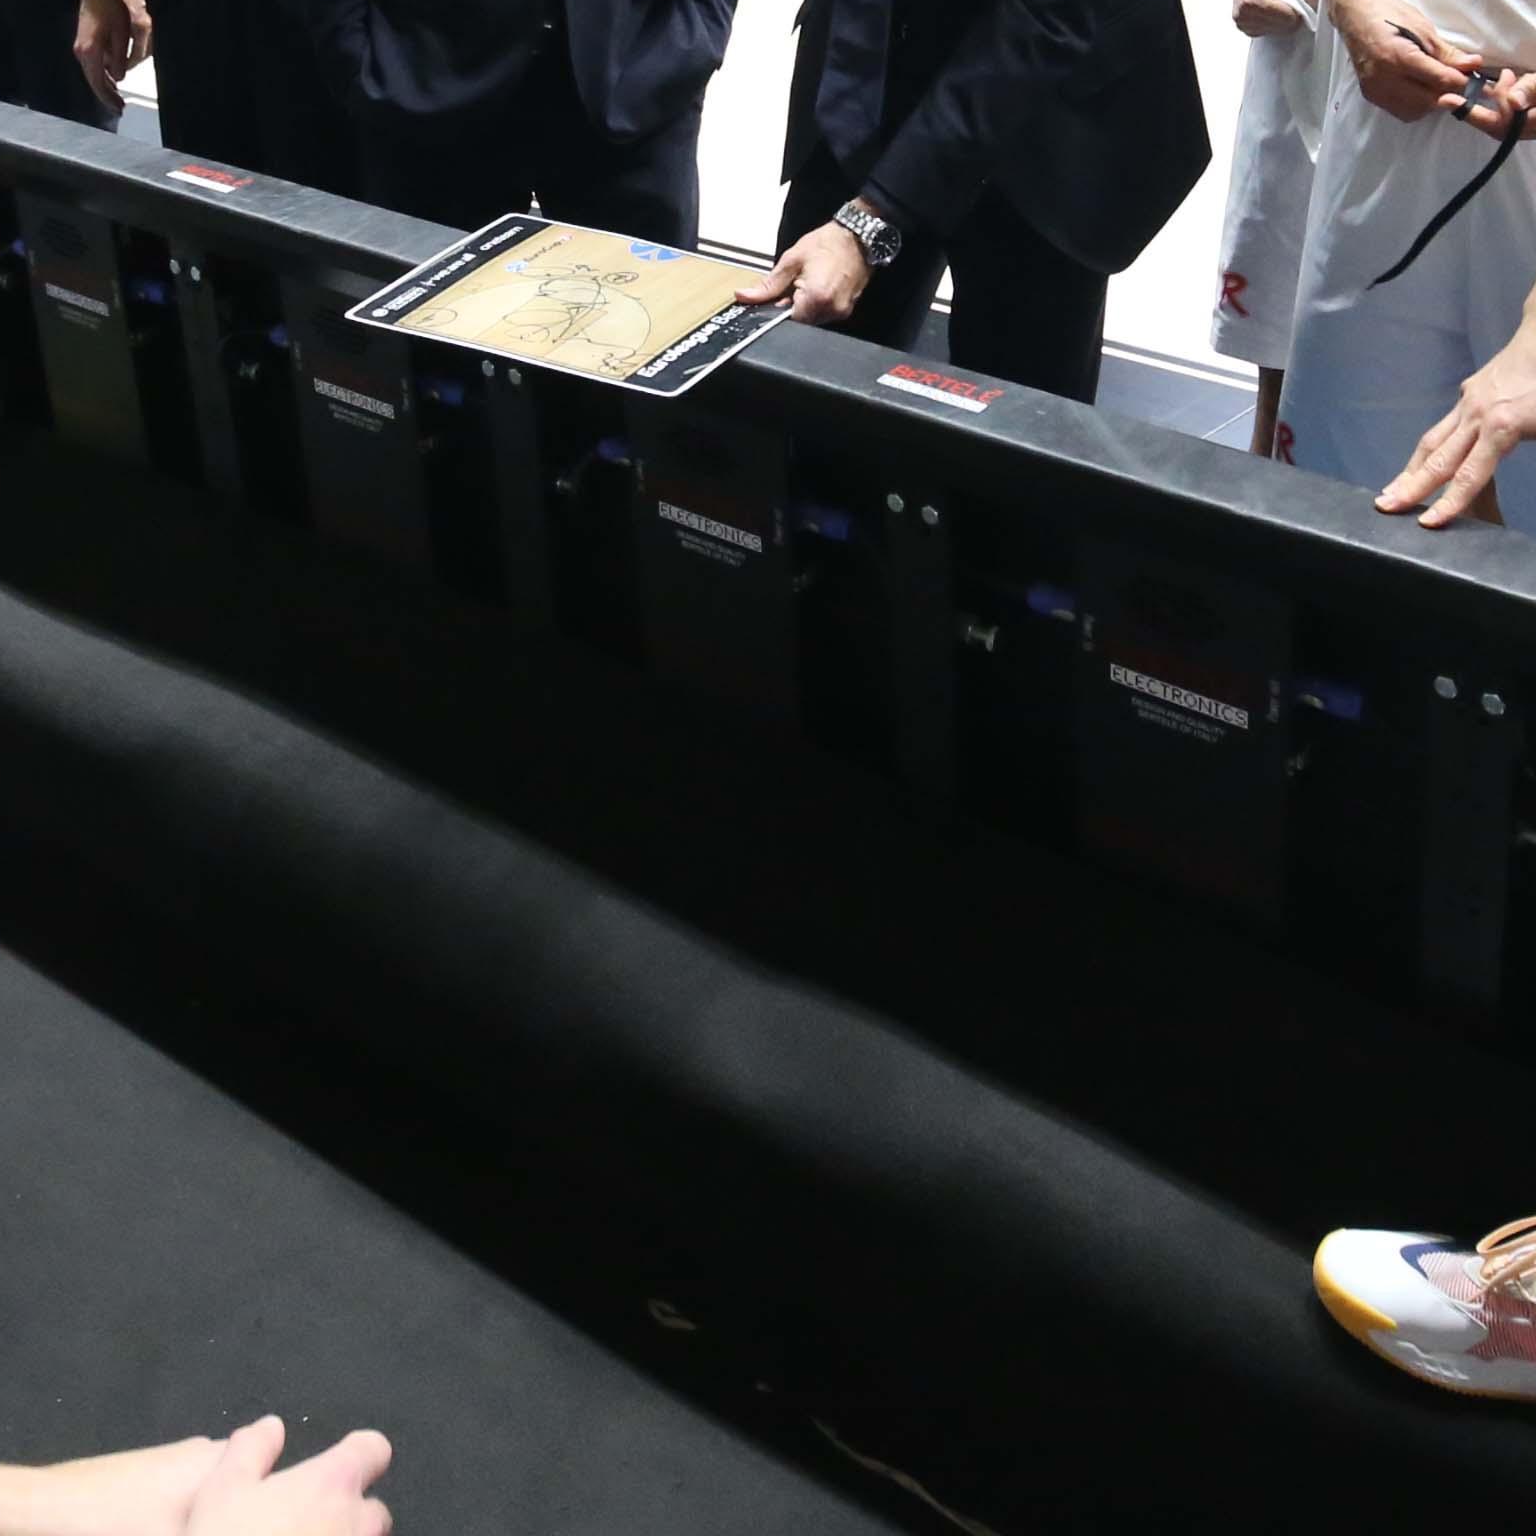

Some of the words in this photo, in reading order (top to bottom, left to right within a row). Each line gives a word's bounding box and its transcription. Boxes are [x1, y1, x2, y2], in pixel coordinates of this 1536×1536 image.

[1221, 271, 1251, 318] R
[637, 318, 721, 379] Euroleague
[660, 502, 763, 552] ELECTRONICS
[1110, 664, 1249, 729] ELECTRONICS
